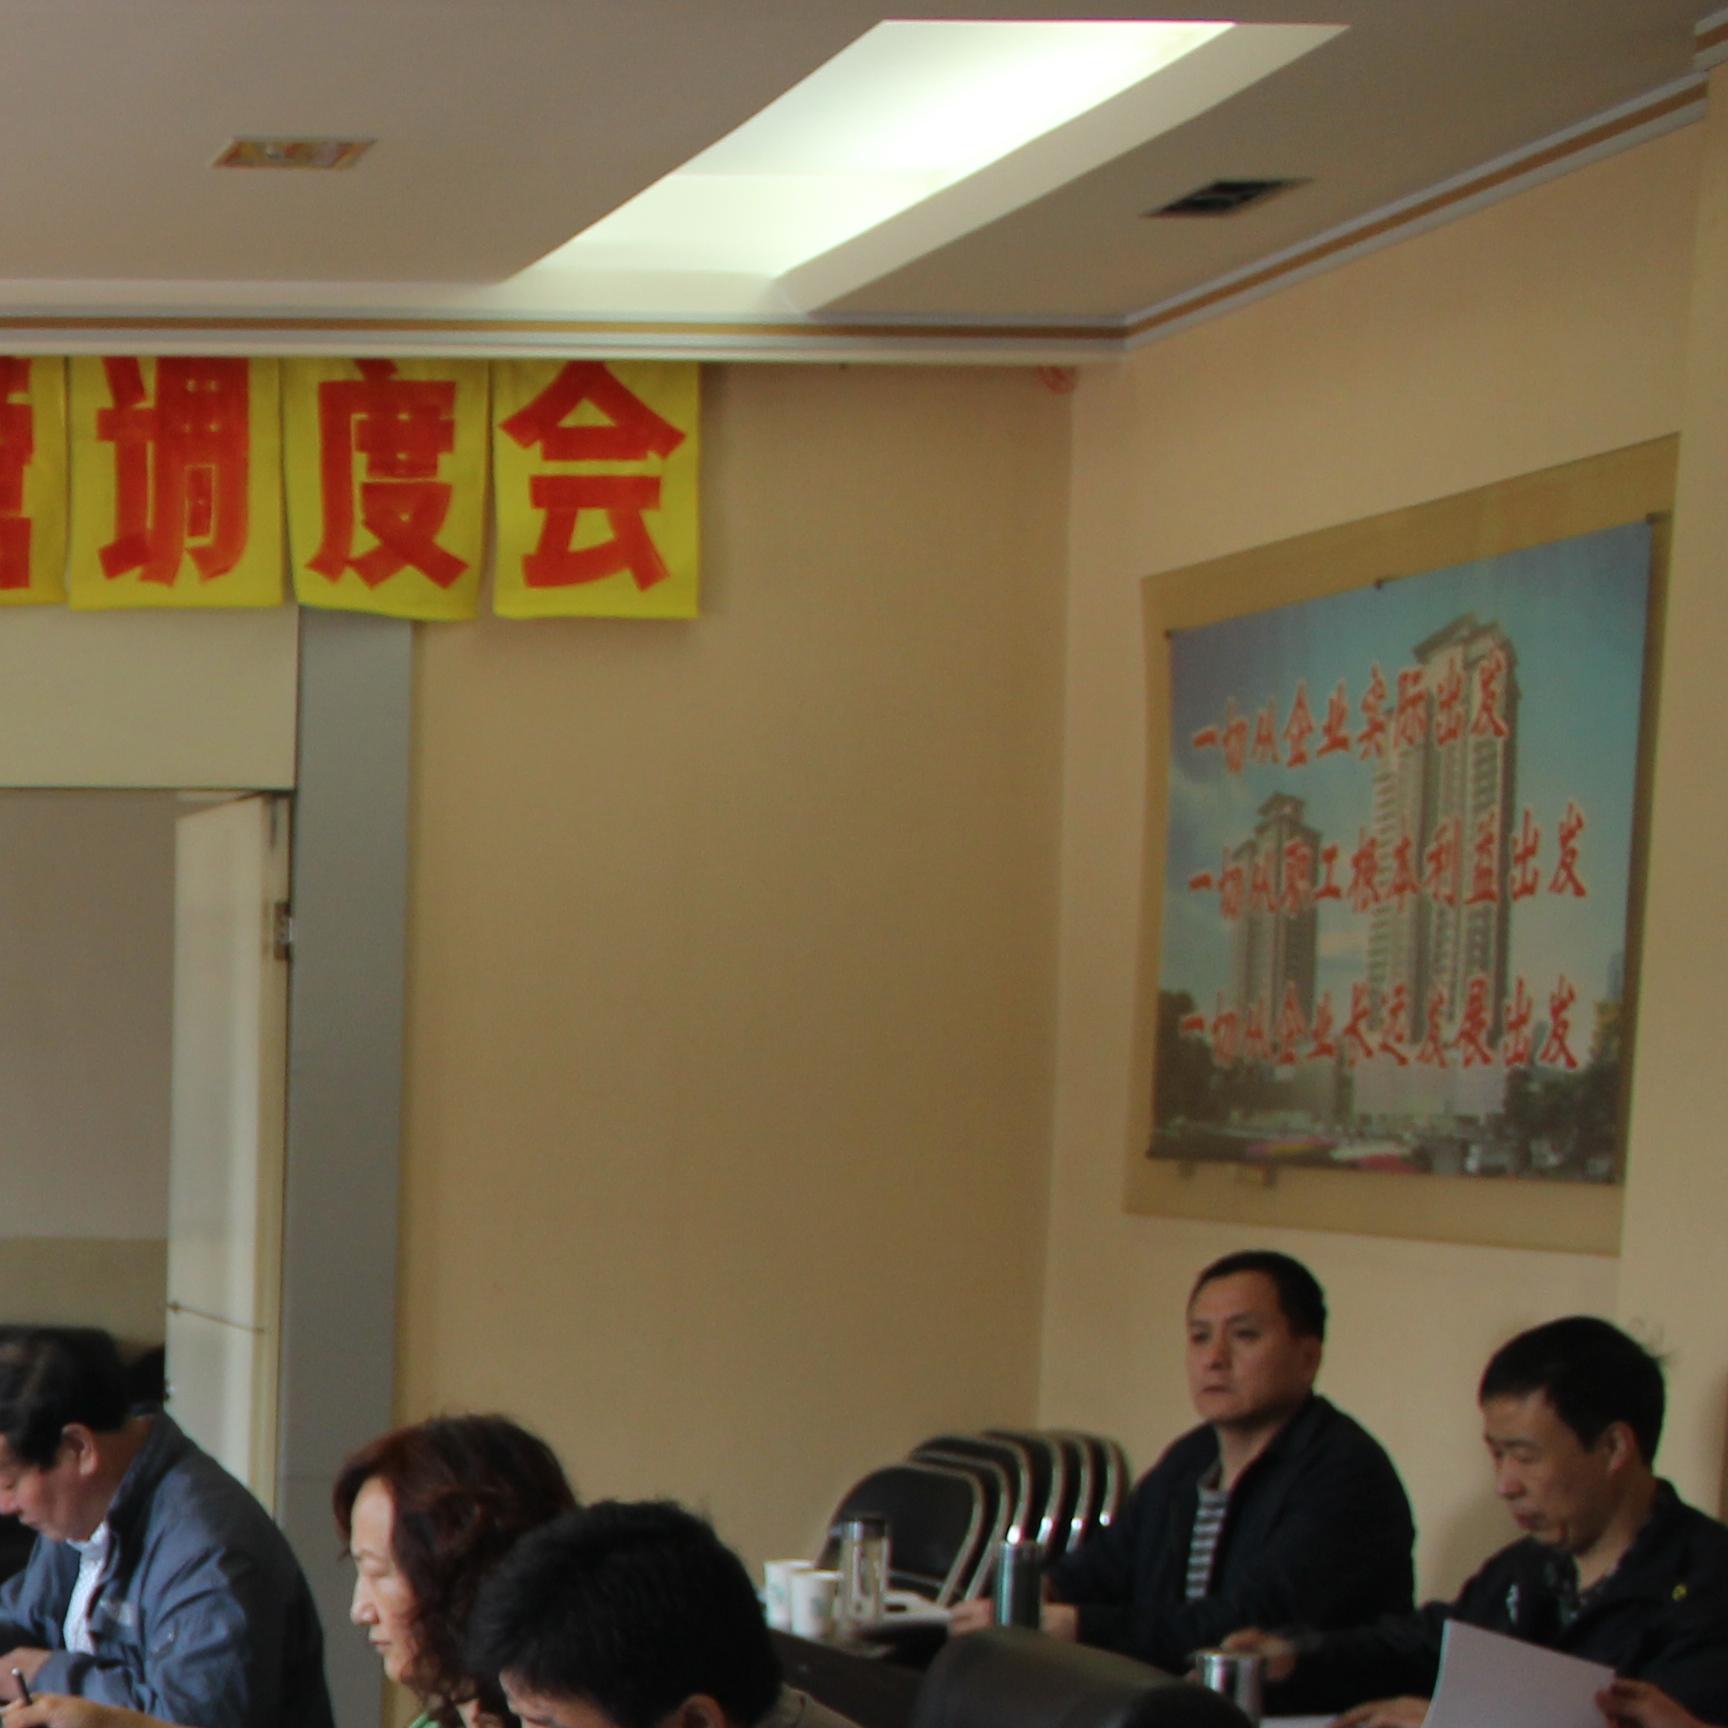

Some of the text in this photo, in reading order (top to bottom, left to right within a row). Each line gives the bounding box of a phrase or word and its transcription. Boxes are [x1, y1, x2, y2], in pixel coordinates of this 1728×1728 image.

[1193, 649, 1509, 774] 一切从企业实际出发
[1188, 802, 1587, 920] 一切从职工根本利益出发
